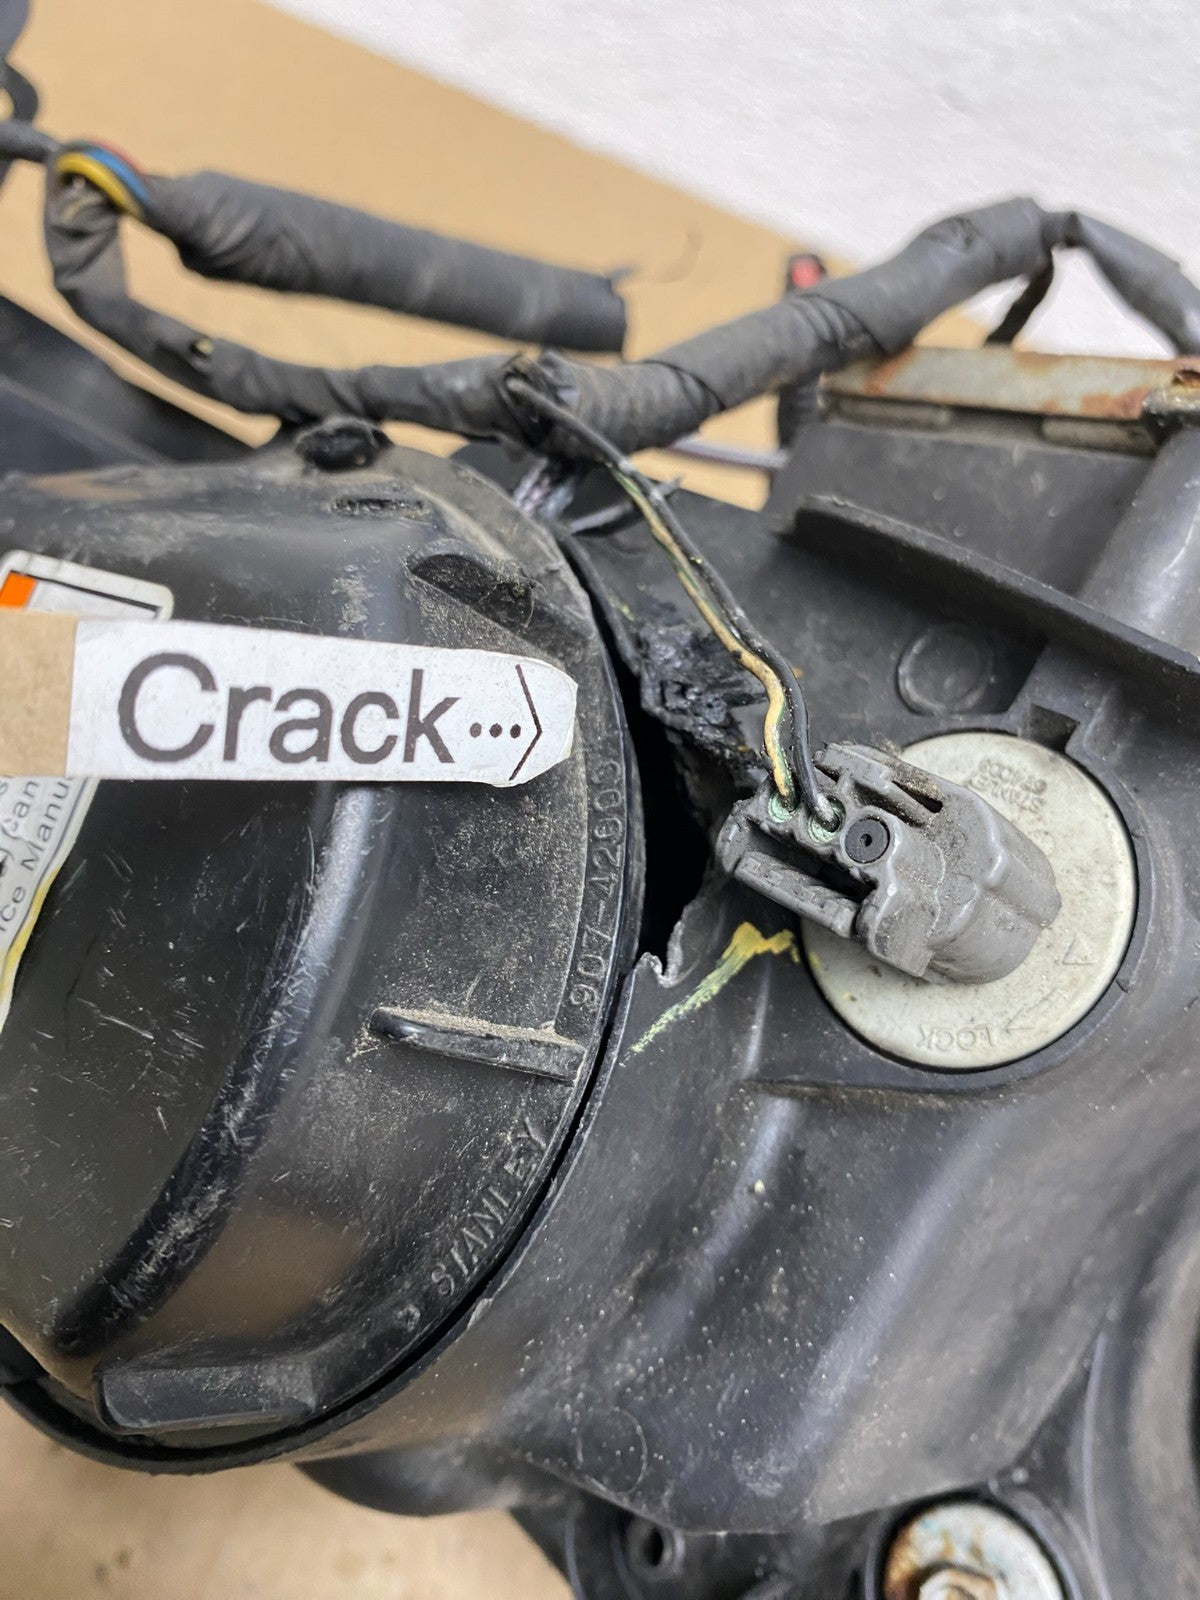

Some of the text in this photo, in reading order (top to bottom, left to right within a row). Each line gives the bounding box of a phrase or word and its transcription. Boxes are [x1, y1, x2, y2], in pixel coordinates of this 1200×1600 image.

[117, 651, 462, 765] Crack
[21, 776, 73, 871] Manu
[431, 1116, 546, 1297] STANLEY
